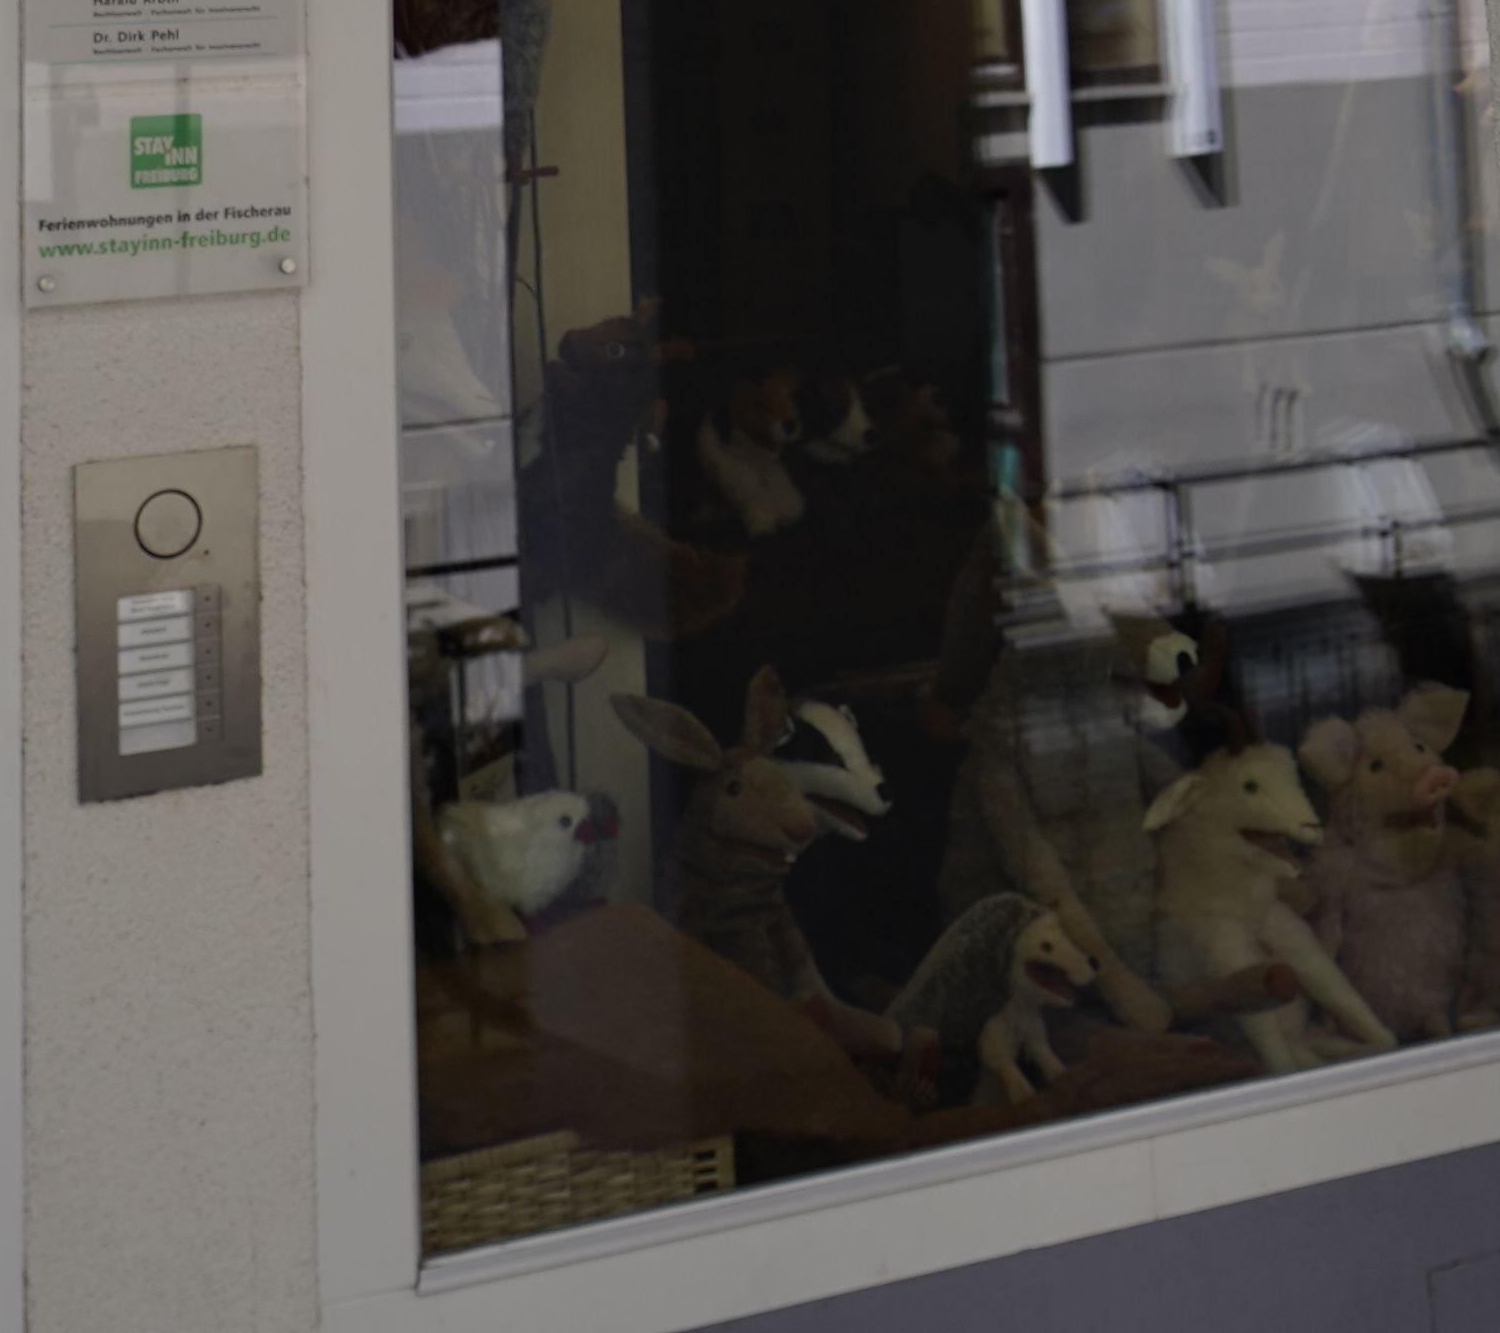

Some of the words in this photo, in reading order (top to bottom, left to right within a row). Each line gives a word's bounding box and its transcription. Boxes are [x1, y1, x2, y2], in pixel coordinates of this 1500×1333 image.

[93, 32, 112, 44] Dr.
[117, 30, 145, 42] Dirk
[152, 28, 180, 41] Pehl
[134, 136, 175, 156] STAY
[38, 212, 173, 232] Ferienwohnungen
[177, 210, 190, 223] in
[195, 208, 218, 221] der
[224, 204, 292, 219] Fischerau
[38, 226, 291, 258] www.stayinn-freiburg.de
